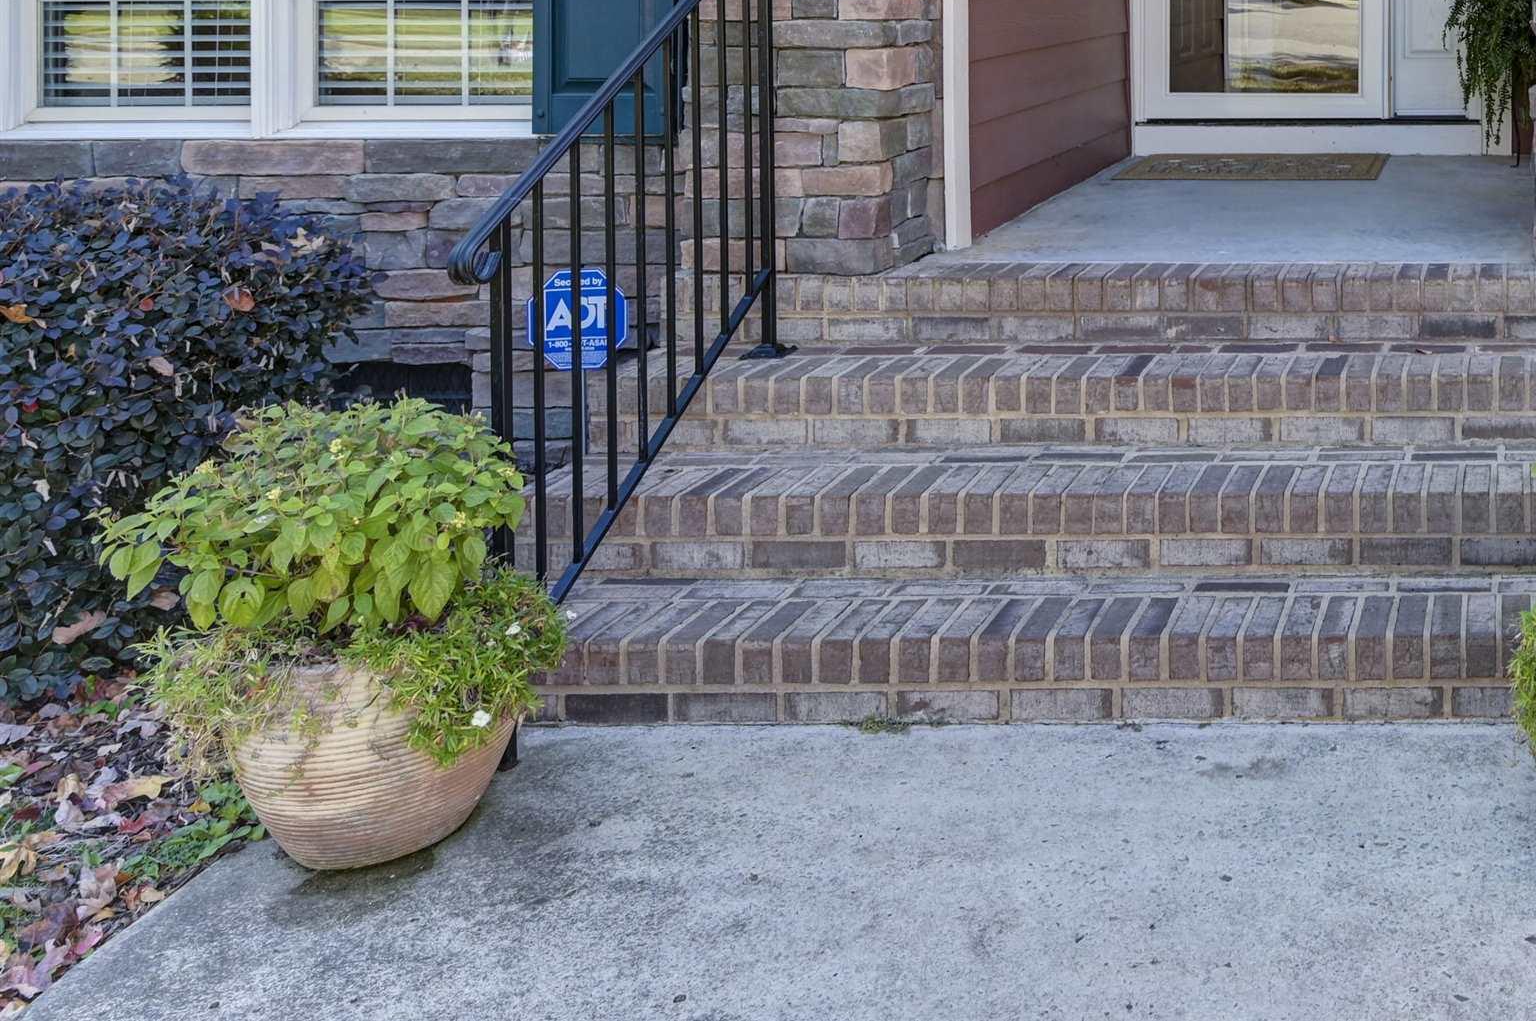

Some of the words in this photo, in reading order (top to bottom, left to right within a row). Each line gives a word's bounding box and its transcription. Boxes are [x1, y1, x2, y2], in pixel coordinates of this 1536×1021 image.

[554, 278, 590, 287] Seced
[592, 277, 603, 286] by
[546, 296, 607, 331] ADT
[548, 339, 607, 348] 1-800-T-ASA
